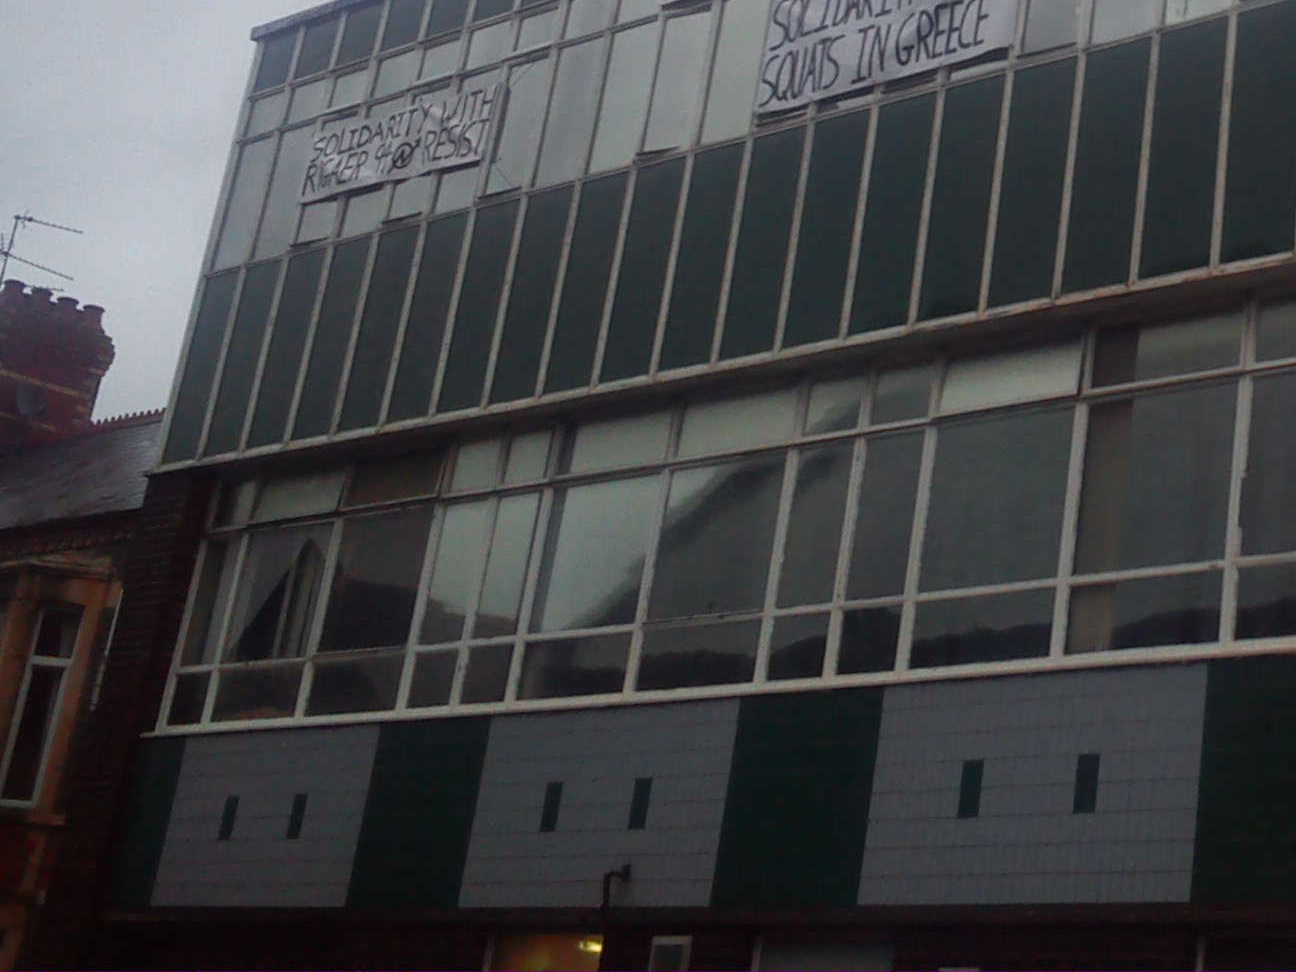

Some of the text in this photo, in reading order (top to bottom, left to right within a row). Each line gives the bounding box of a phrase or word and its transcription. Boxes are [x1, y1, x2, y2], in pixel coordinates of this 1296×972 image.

[758, 33, 846, 108] SQUATS
[851, 24, 892, 84] IN
[310, 85, 500, 163] SOLIDARITY WITH
